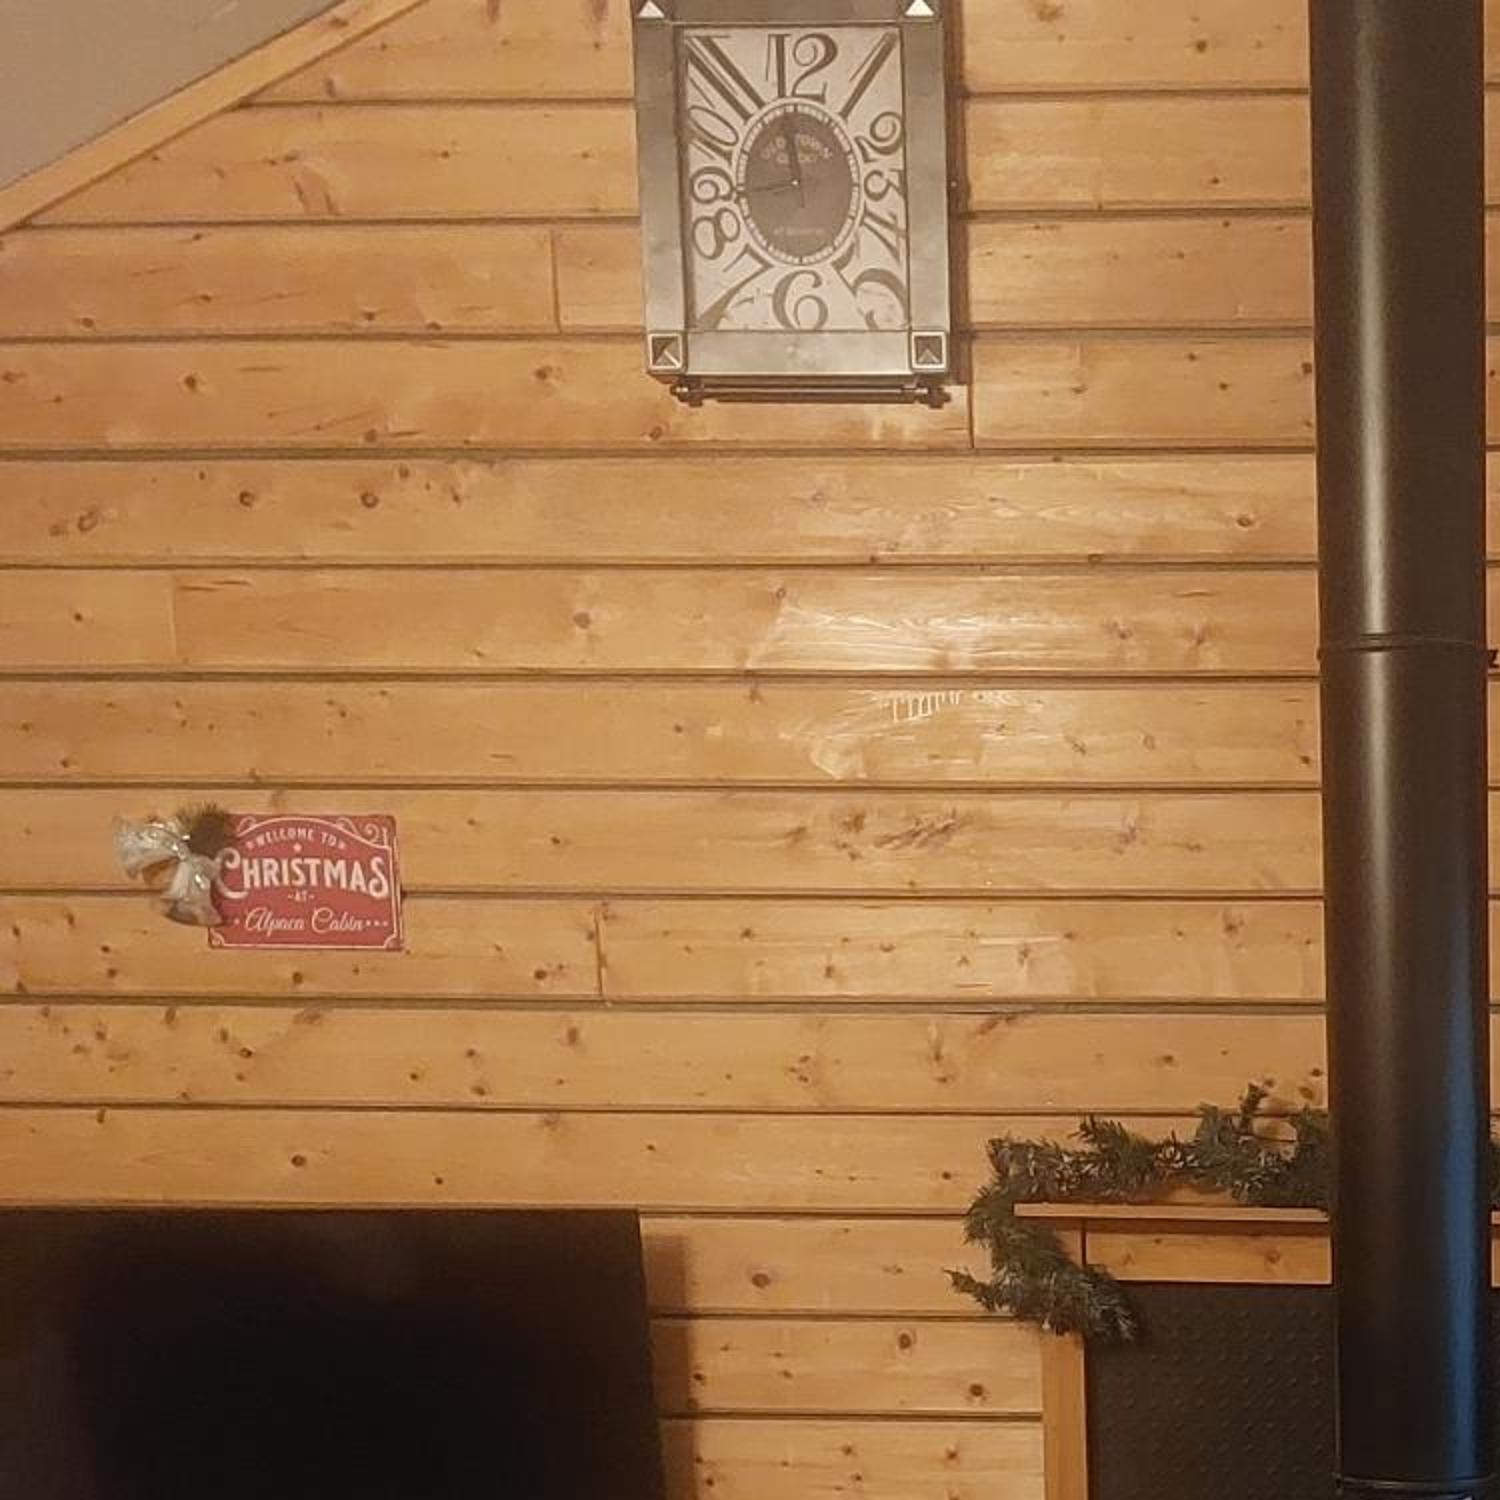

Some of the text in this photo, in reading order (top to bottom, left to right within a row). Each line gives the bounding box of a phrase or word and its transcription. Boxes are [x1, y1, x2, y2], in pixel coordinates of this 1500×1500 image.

[765, 33, 838, 104] 12
[687, 105, 741, 166] 10
[854, 111, 903, 163] 2
[691, 166, 736, 204] 9
[864, 168, 907, 202] 3
[692, 207, 740, 260] 8
[771, 269, 828, 331] 6
[255, 827, 337, 847] WELCOME TO
[218, 847, 390, 899] CHRISTMAS
[311, 906, 364, 934] Cabin
